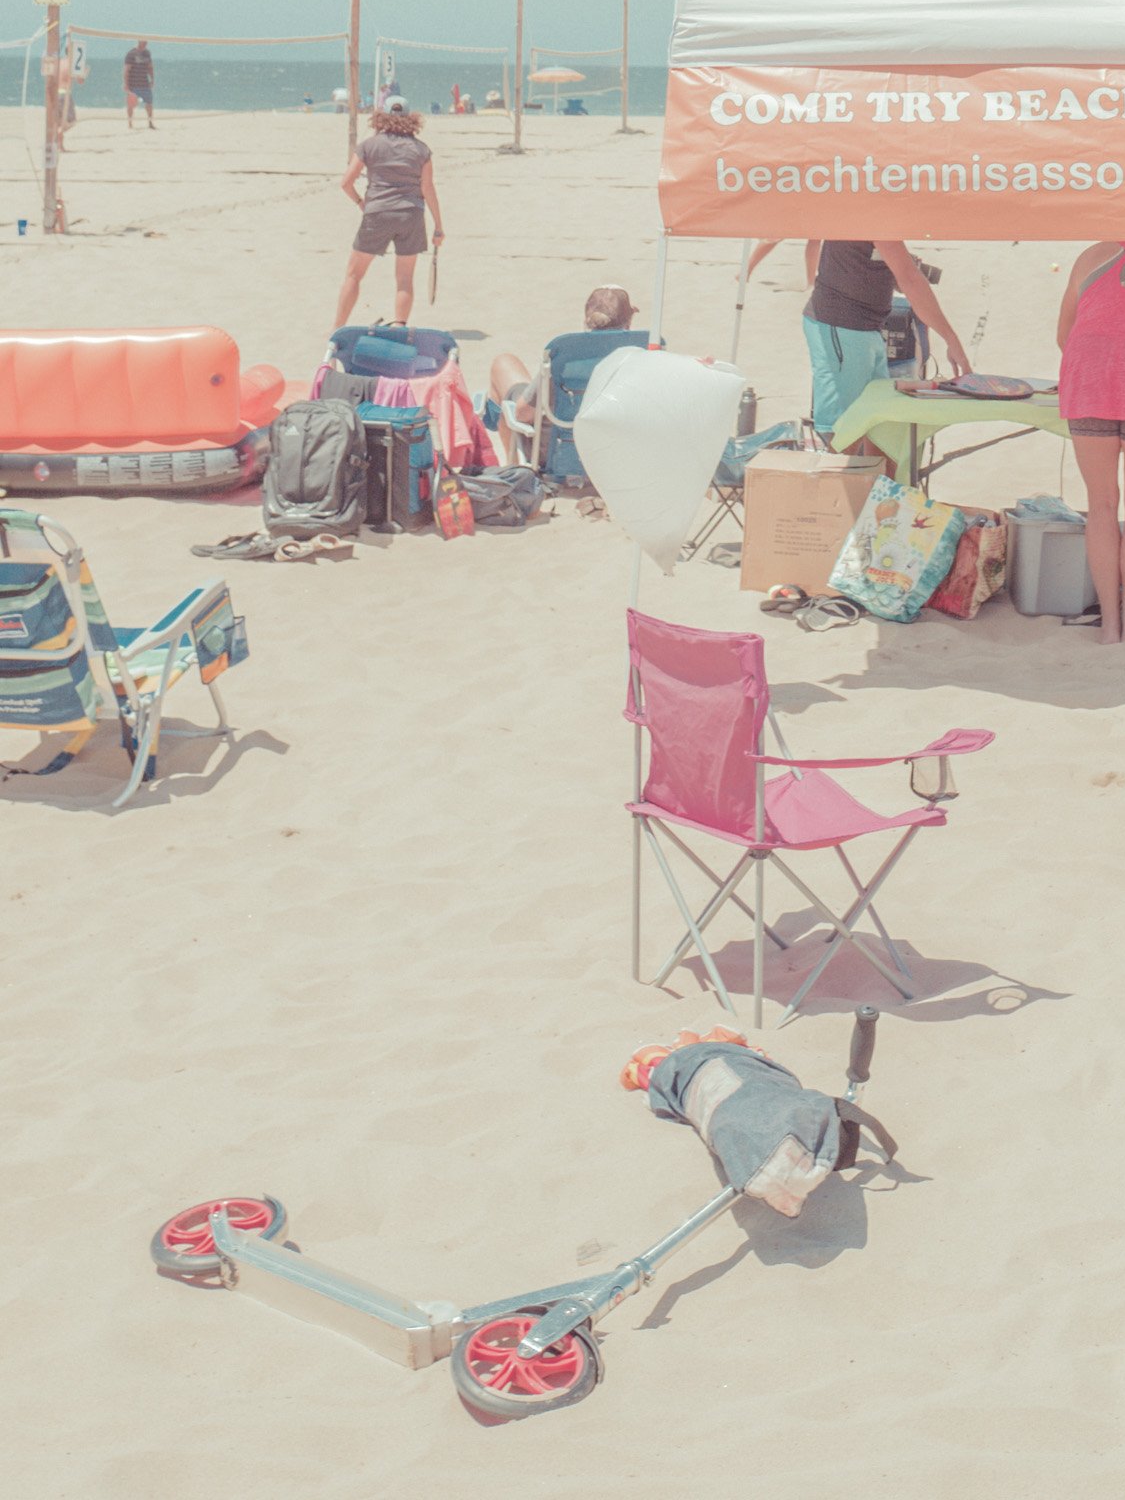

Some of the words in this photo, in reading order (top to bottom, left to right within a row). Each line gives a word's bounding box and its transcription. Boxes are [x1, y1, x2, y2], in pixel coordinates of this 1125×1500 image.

[74, 46, 84, 71] 2
[709, 92, 854, 126] COME
[866, 91, 971, 123] TRY
